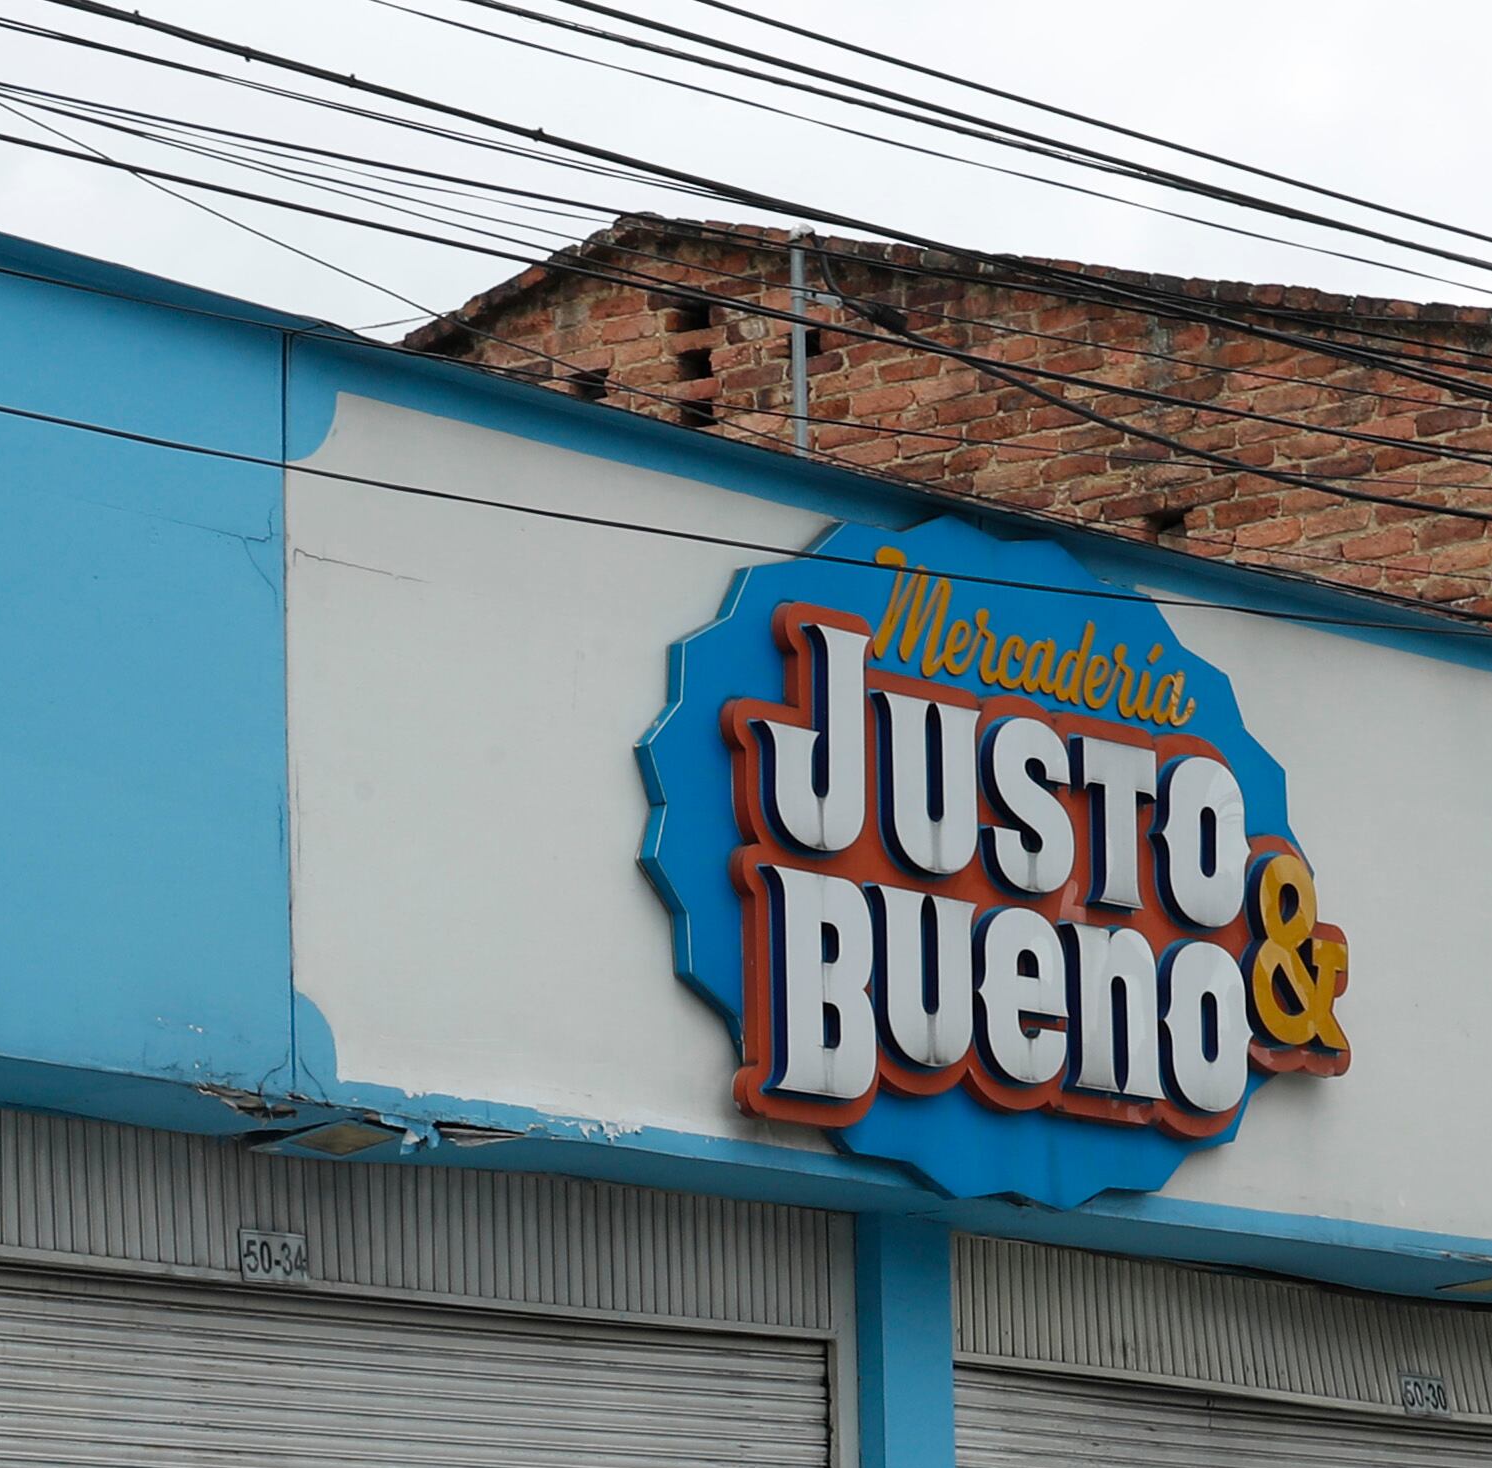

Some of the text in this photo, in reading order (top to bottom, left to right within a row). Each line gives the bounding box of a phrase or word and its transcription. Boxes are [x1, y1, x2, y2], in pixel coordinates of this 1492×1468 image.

[874, 546, 1195, 728] Mercadería
[243, 1239, 307, 1278] 50-34
[1403, 1380, 1448, 1411] 50-30
